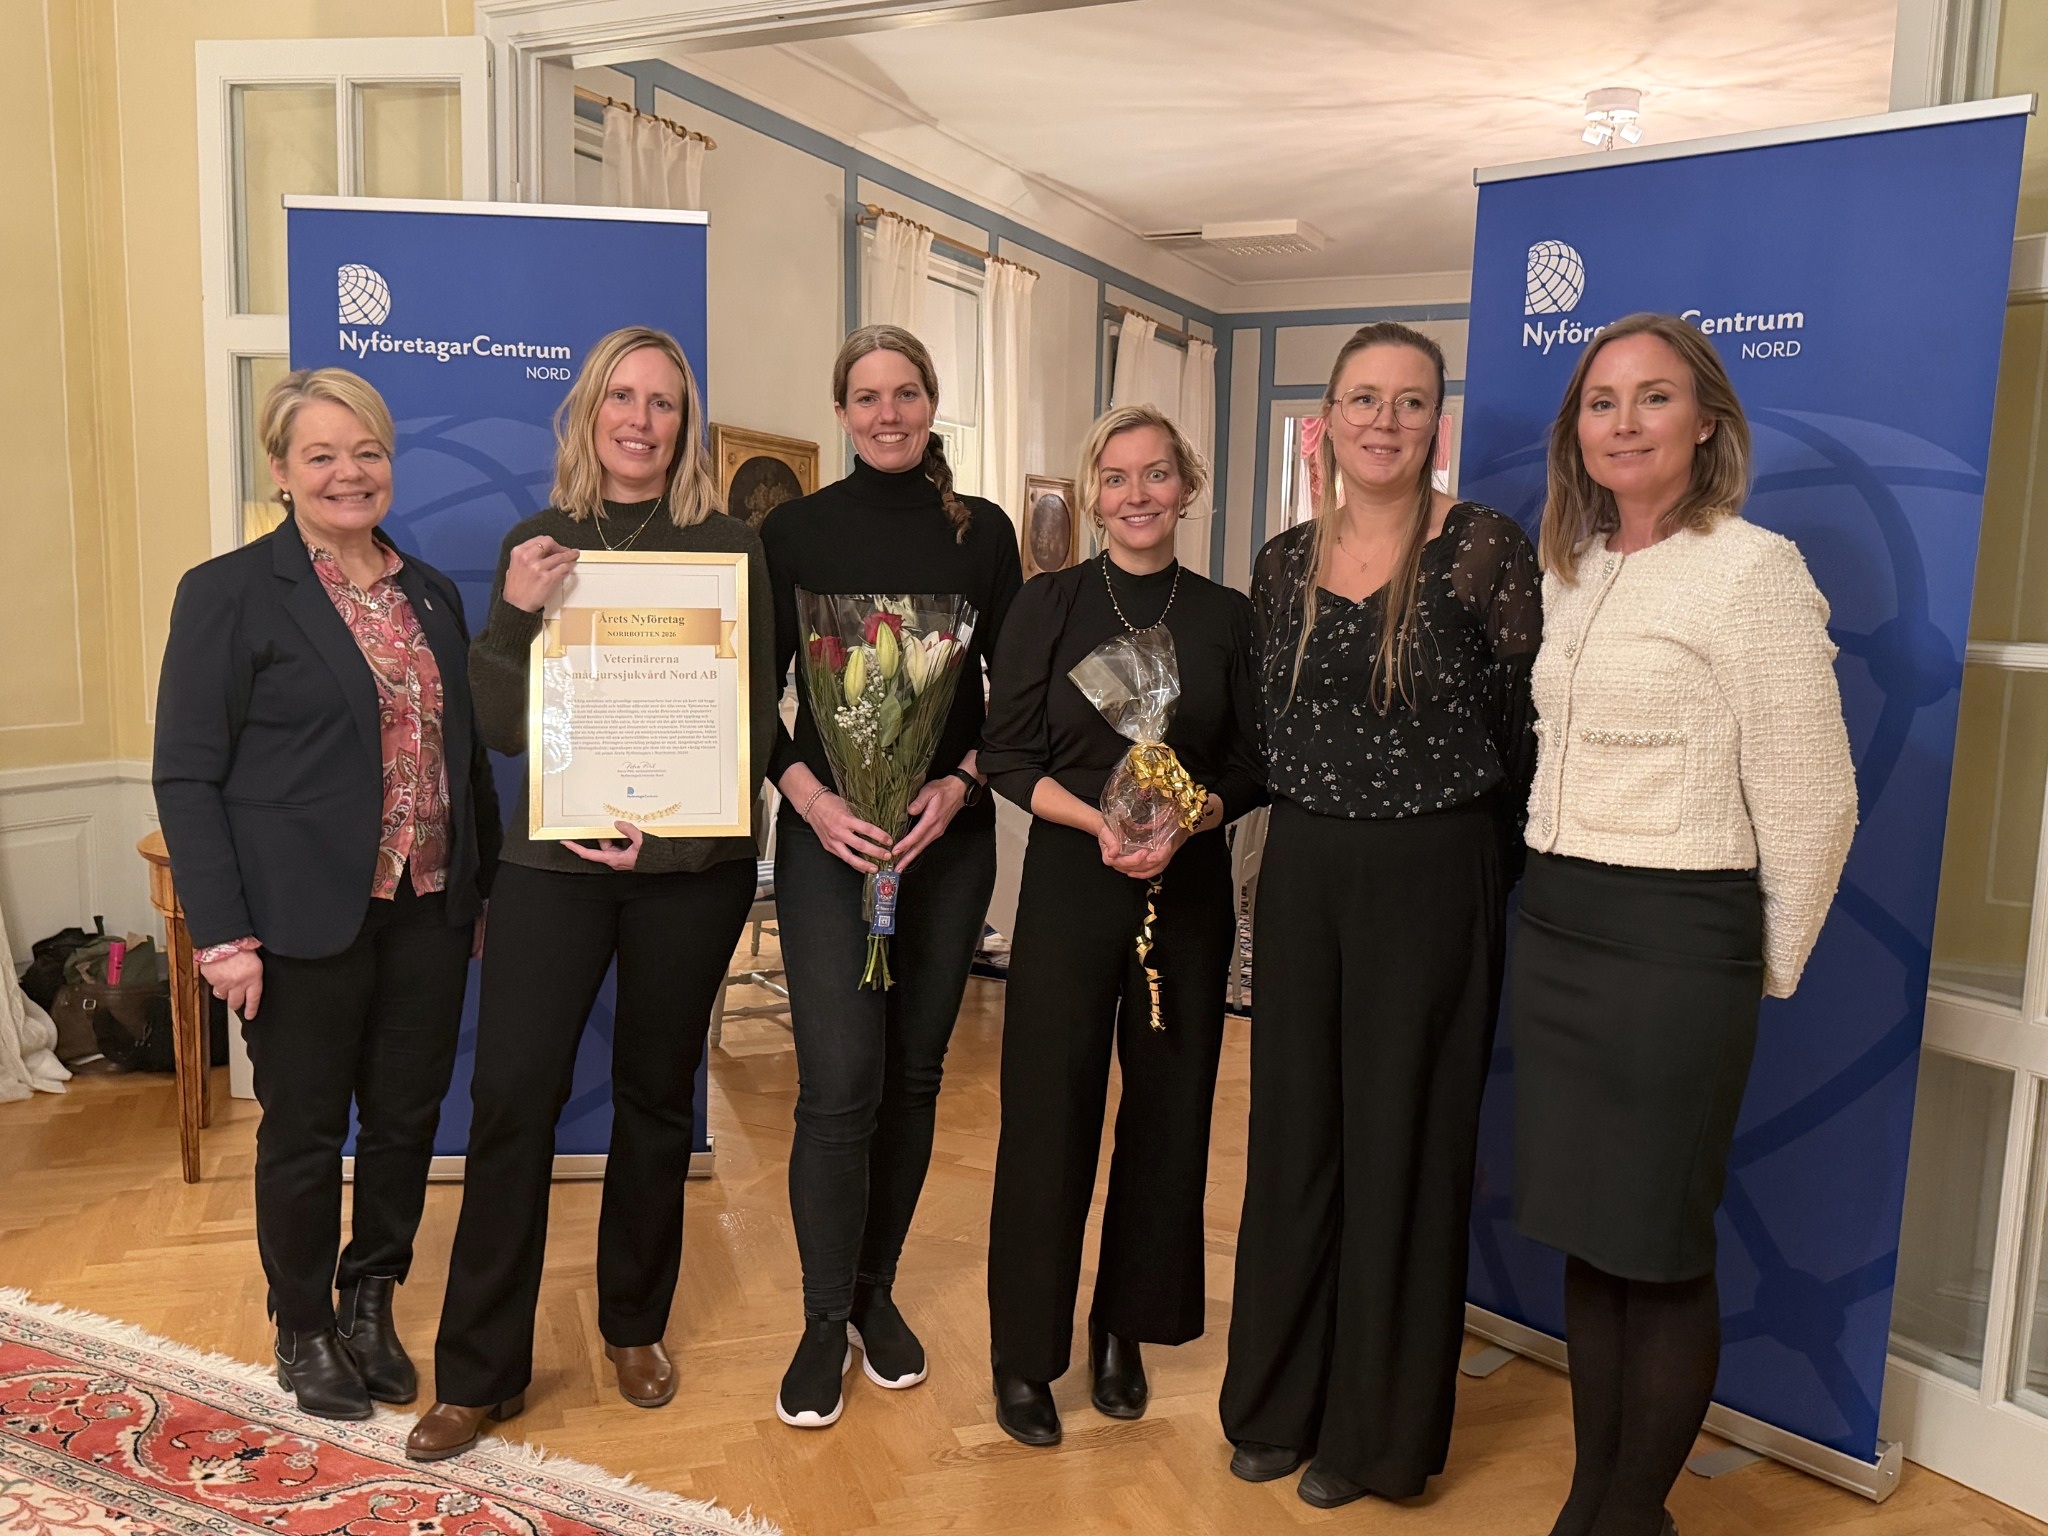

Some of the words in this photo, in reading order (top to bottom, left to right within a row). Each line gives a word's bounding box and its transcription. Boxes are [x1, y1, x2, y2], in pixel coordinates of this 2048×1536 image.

[1522, 309, 1804, 355] Nyförentrum
[339, 330, 571, 362] NyföretagarCentrum
[1741, 340, 1801, 359] NORD
[526, 366, 571, 380] NORD
[599, 613, 628, 624] Årets
[631, 614, 685, 626] Nyföretag
[603, 654, 680, 664] Veterinärerna
[670, 670, 698, 680] Nord
[700, 670, 718, 680] AB
